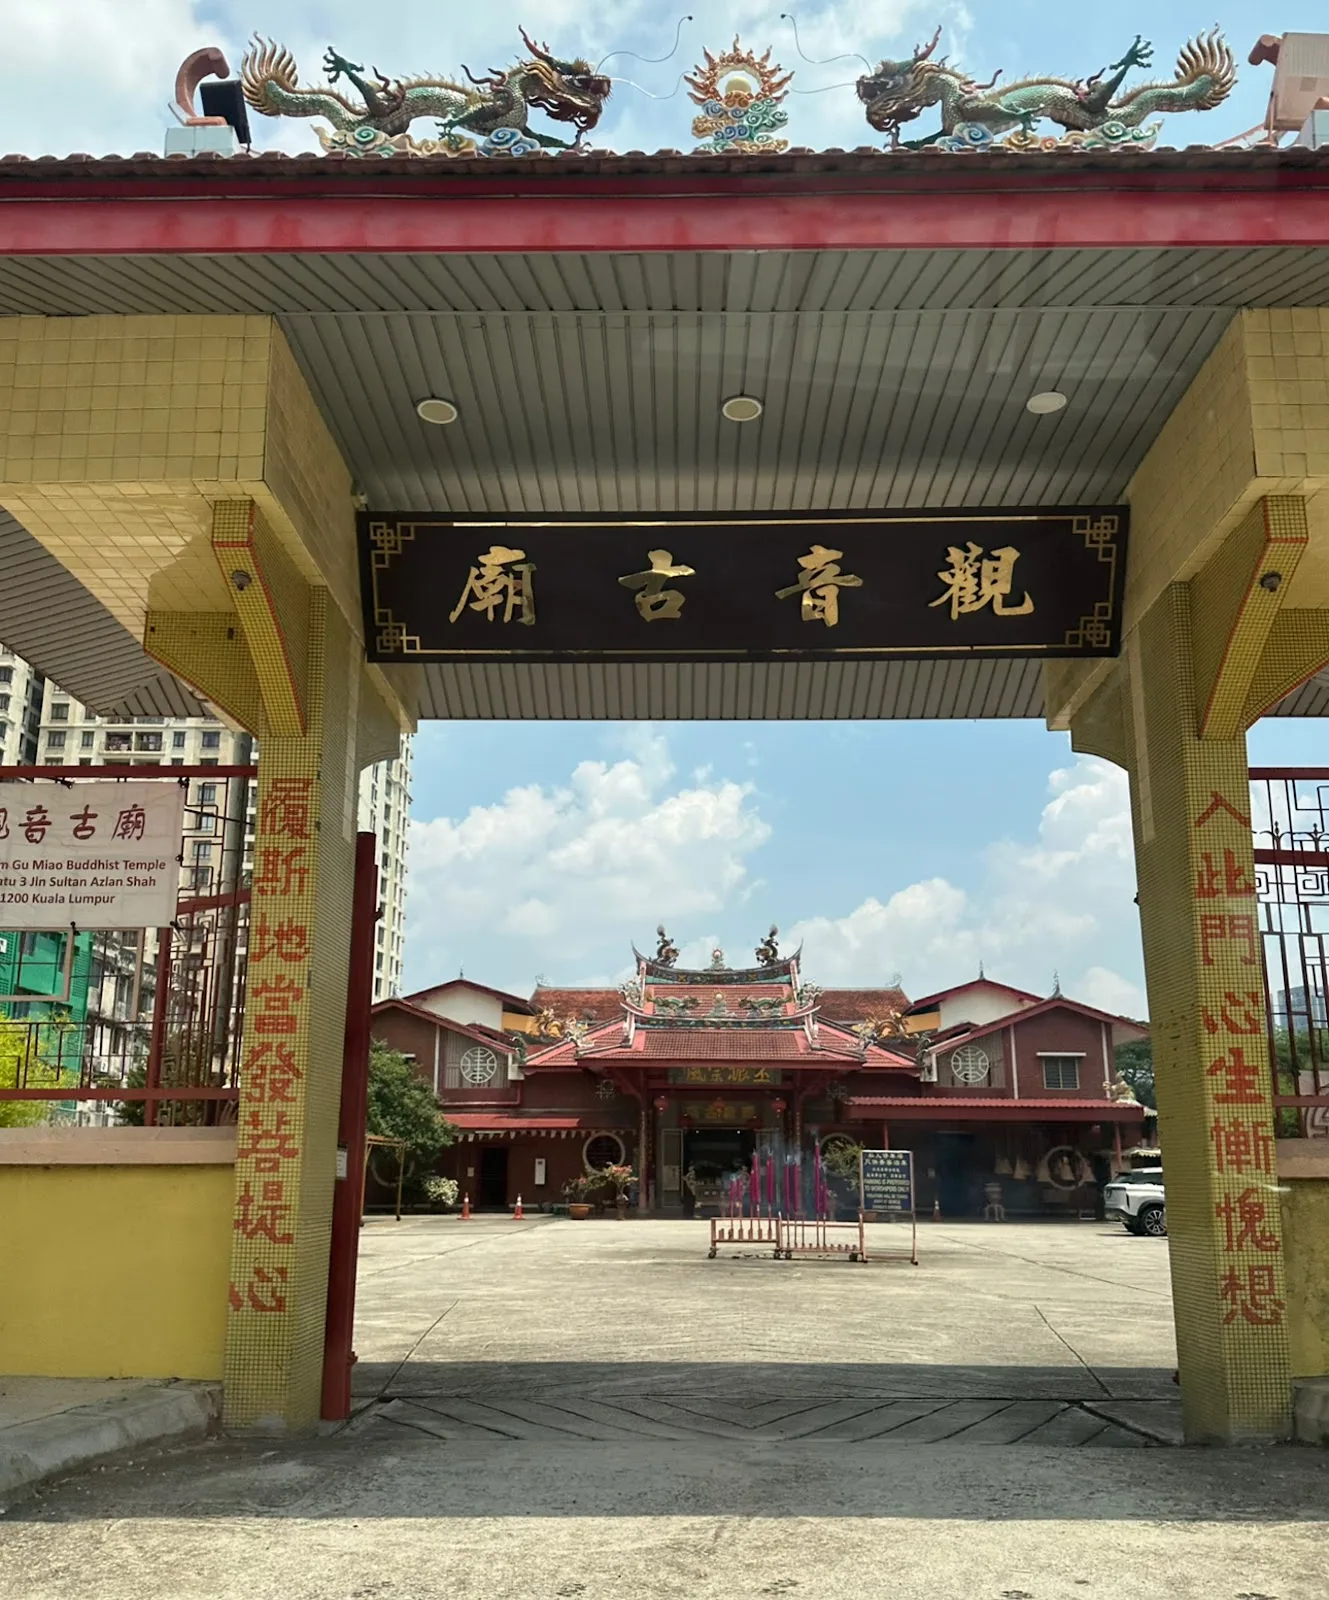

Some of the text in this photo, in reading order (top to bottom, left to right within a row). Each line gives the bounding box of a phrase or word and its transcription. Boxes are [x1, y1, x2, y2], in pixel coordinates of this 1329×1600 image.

[449, 541, 1034, 627] 觀音古廟
[0, 803, 146, 844] 音古廟
[12, 859, 29, 870] Gu
[32, 859, 63, 870] Miao
[66, 859, 120, 871] Buddhist
[122, 859, 166, 872] Temple
[19, 876, 27, 887] 3
[29, 876, 46, 887] Jln
[49, 876, 87, 887] Sultan
[90, 876, 123, 887] Azlan
[126, 876, 156, 887] Shah
[0, 892, 116, 906] 1200 Kuala Lumpur
[228, 777, 314, 1313] 履斯地當發菩提心
[1194, 790, 1286, 1326] 入此門心生慚愧想
